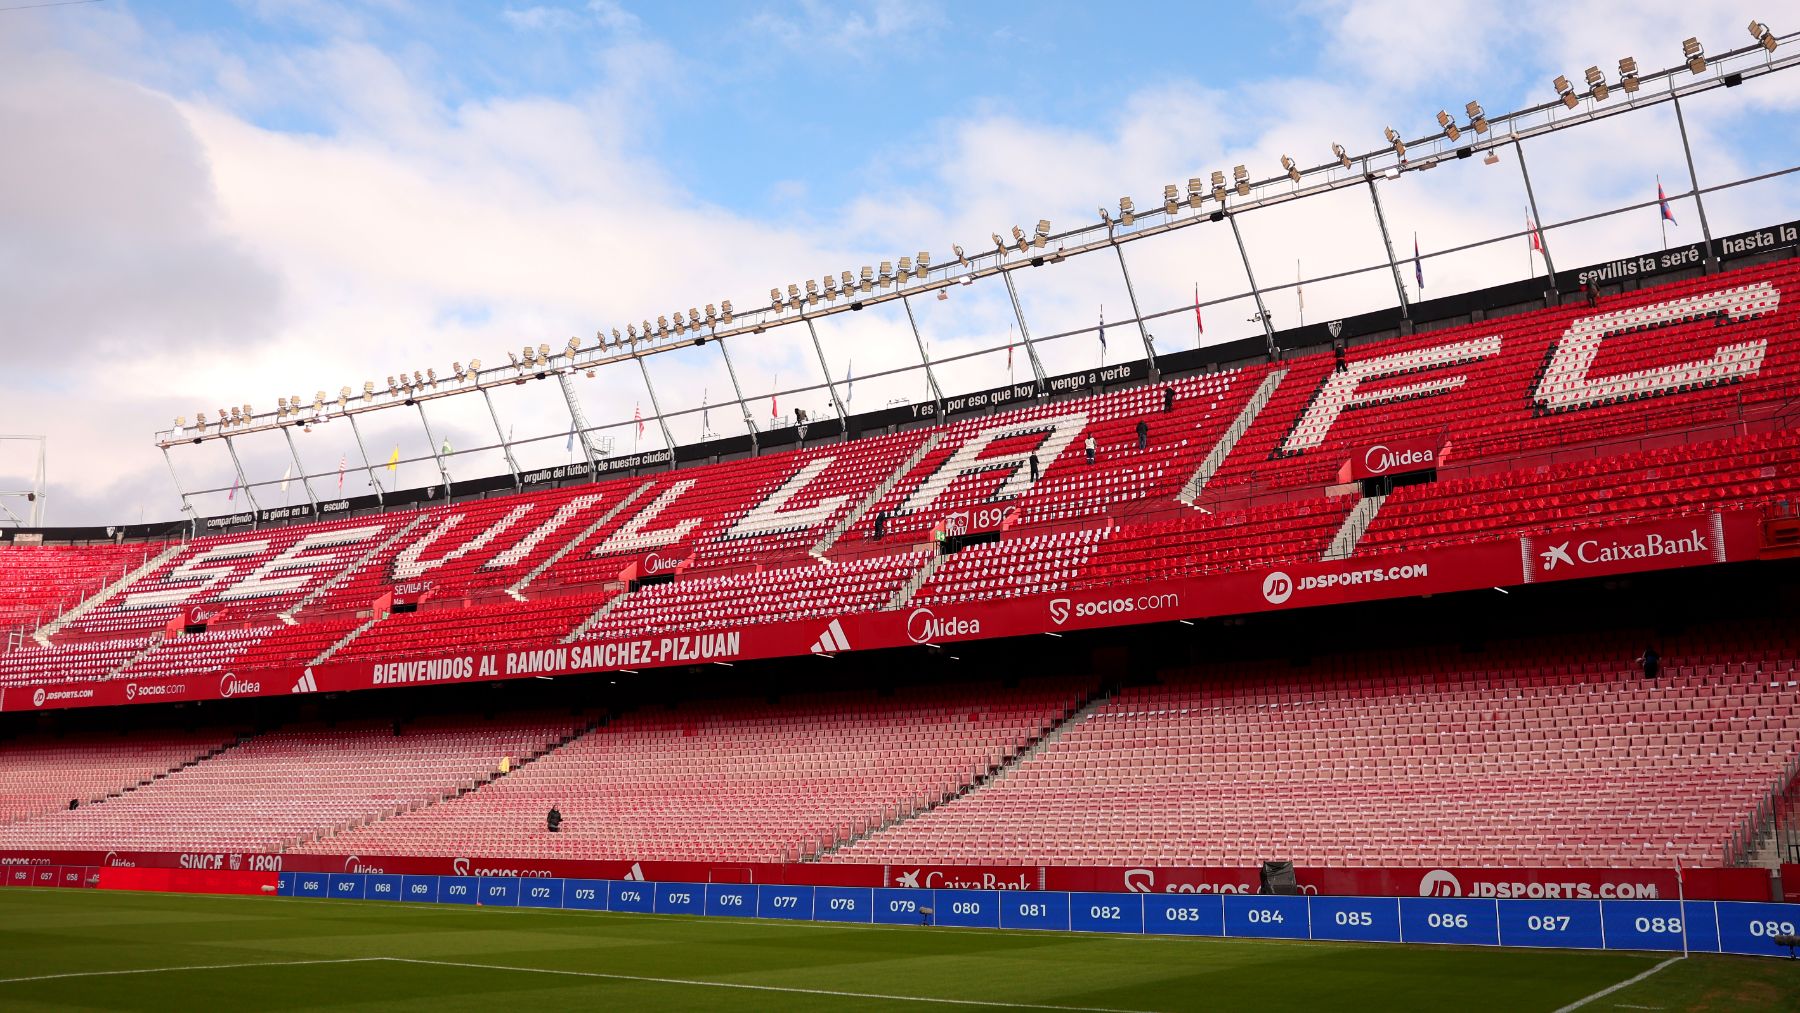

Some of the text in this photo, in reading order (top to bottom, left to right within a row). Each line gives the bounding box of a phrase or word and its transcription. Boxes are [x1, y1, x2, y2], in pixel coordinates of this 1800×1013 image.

[1722, 225, 1797, 255] hasta la
[1661, 245, 1699, 269] seré
[1051, 365, 1131, 392] vengo a verte
[947, 384, 1035, 414] por eso que hoy
[911, 404, 934, 418] Y es
[598, 450, 671, 473] de nuestra ciudad
[1365, 445, 1434, 474] Midea
[524, 461, 590, 485] orgullo del fútbol
[262, 505, 310, 521] la gloria en tu
[323, 500, 350, 513] escudo
[207, 513, 253, 528] compartiendo
[1577, 528, 1709, 564] CaixaBank
[1297, 563, 1429, 591] JDSPORTS.COM
[394, 582, 421, 596] SEVILLA
[907, 608, 980, 644] Midea
[372, 632, 741, 685] BIENVENIDOS AL RAMON SANCHEZ-PIZJUAN
[220, 672, 260, 698] Midea
[179, 853, 282, 872] SINCE 1890
[14, 871, 27, 880] 056
[40, 872, 53, 880] 057
[66, 873, 79, 881] 058
[303, 881, 319, 891] 066
[338, 882, 355, 892] 067
[374, 883, 391, 893] 068
[411, 884, 428, 894] 069
[449, 885, 467, 896] 070
[489, 886, 506, 897] 071
[531, 887, 550, 898] 072
[575, 889, 595, 900] 073
[620, 891, 641, 902] 074
[668, 893, 691, 904] 075
[720, 894, 743, 906] 076
[773, 896, 798, 908] 077
[830, 898, 855, 911] 078
[889, 900, 916, 913] 079
[952, 902, 980, 915] 080
[1019, 903, 1046, 917] 081
[1090, 905, 1121, 920] 082
[1165, 907, 1200, 922] 083
[1248, 909, 1284, 924] 084
[1335, 911, 1373, 926] 085
[1427, 913, 1469, 929] 086
[1527, 915, 1571, 932] 087
[1634, 916, 1683, 934] 088
[1749, 920, 1796, 938] 089
